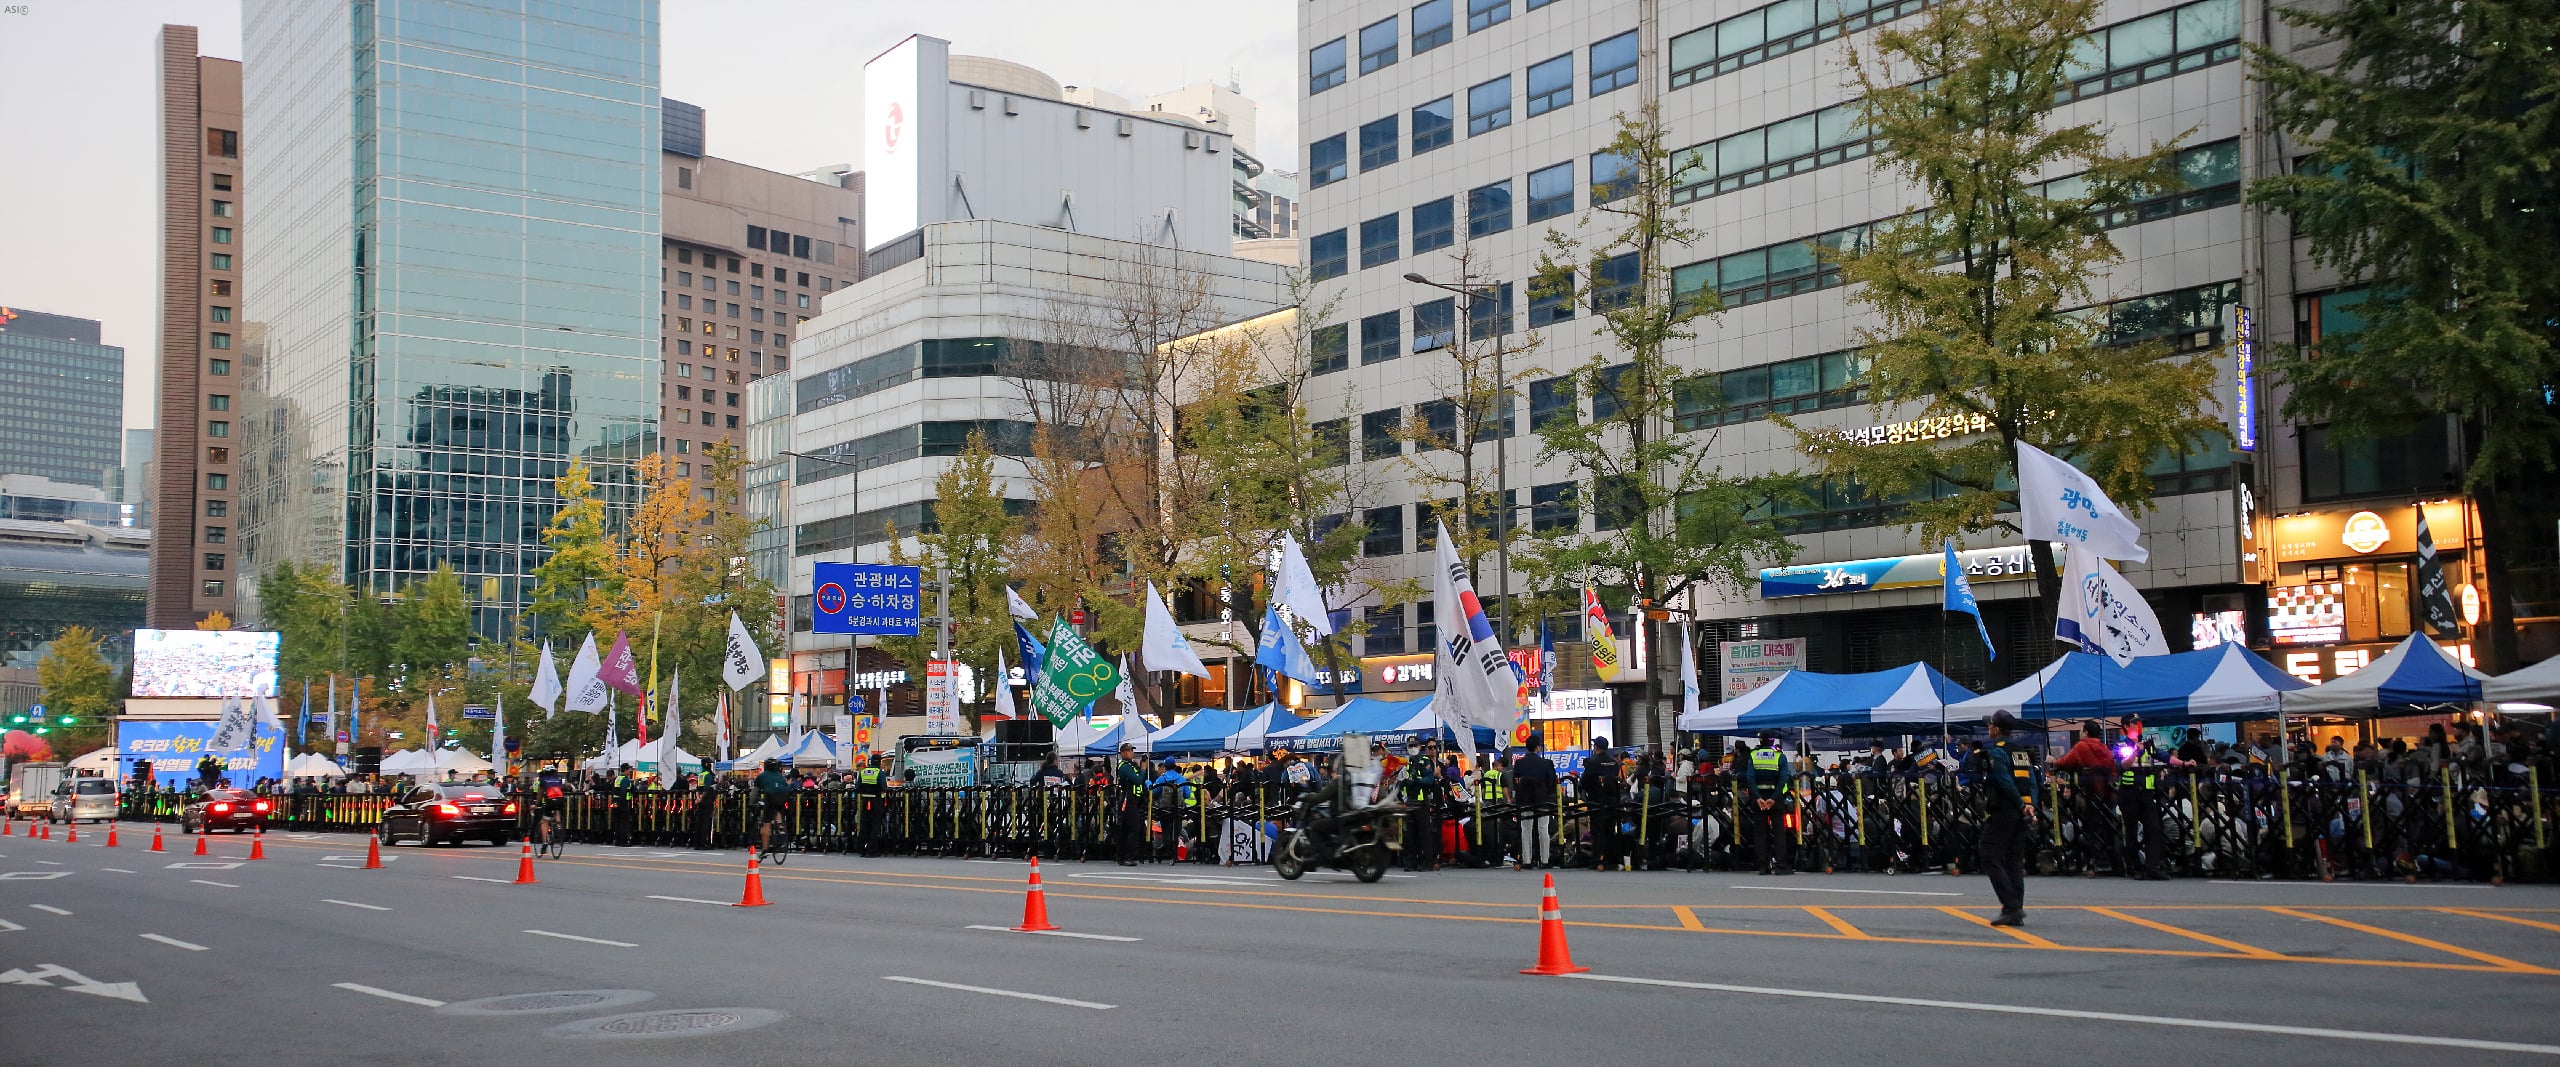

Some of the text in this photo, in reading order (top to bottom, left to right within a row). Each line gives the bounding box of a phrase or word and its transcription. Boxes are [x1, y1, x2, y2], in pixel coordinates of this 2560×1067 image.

[2060, 487, 2099, 519] 광명
[2057, 520, 2088, 542] 촛불행동
[854, 571, 912, 589] 관광버스
[1817, 567, 1847, 589] 365
[851, 592, 914, 610] 승·하차장
[848, 615, 917, 633] 5분경과시 과태료 부과
[1730, 642, 1795, 659] 출자금 대축제
[1397, 664, 1433, 682] 김가네
[130, 740, 169, 752] 우크라
[146, 757, 193, 772] 석열을
